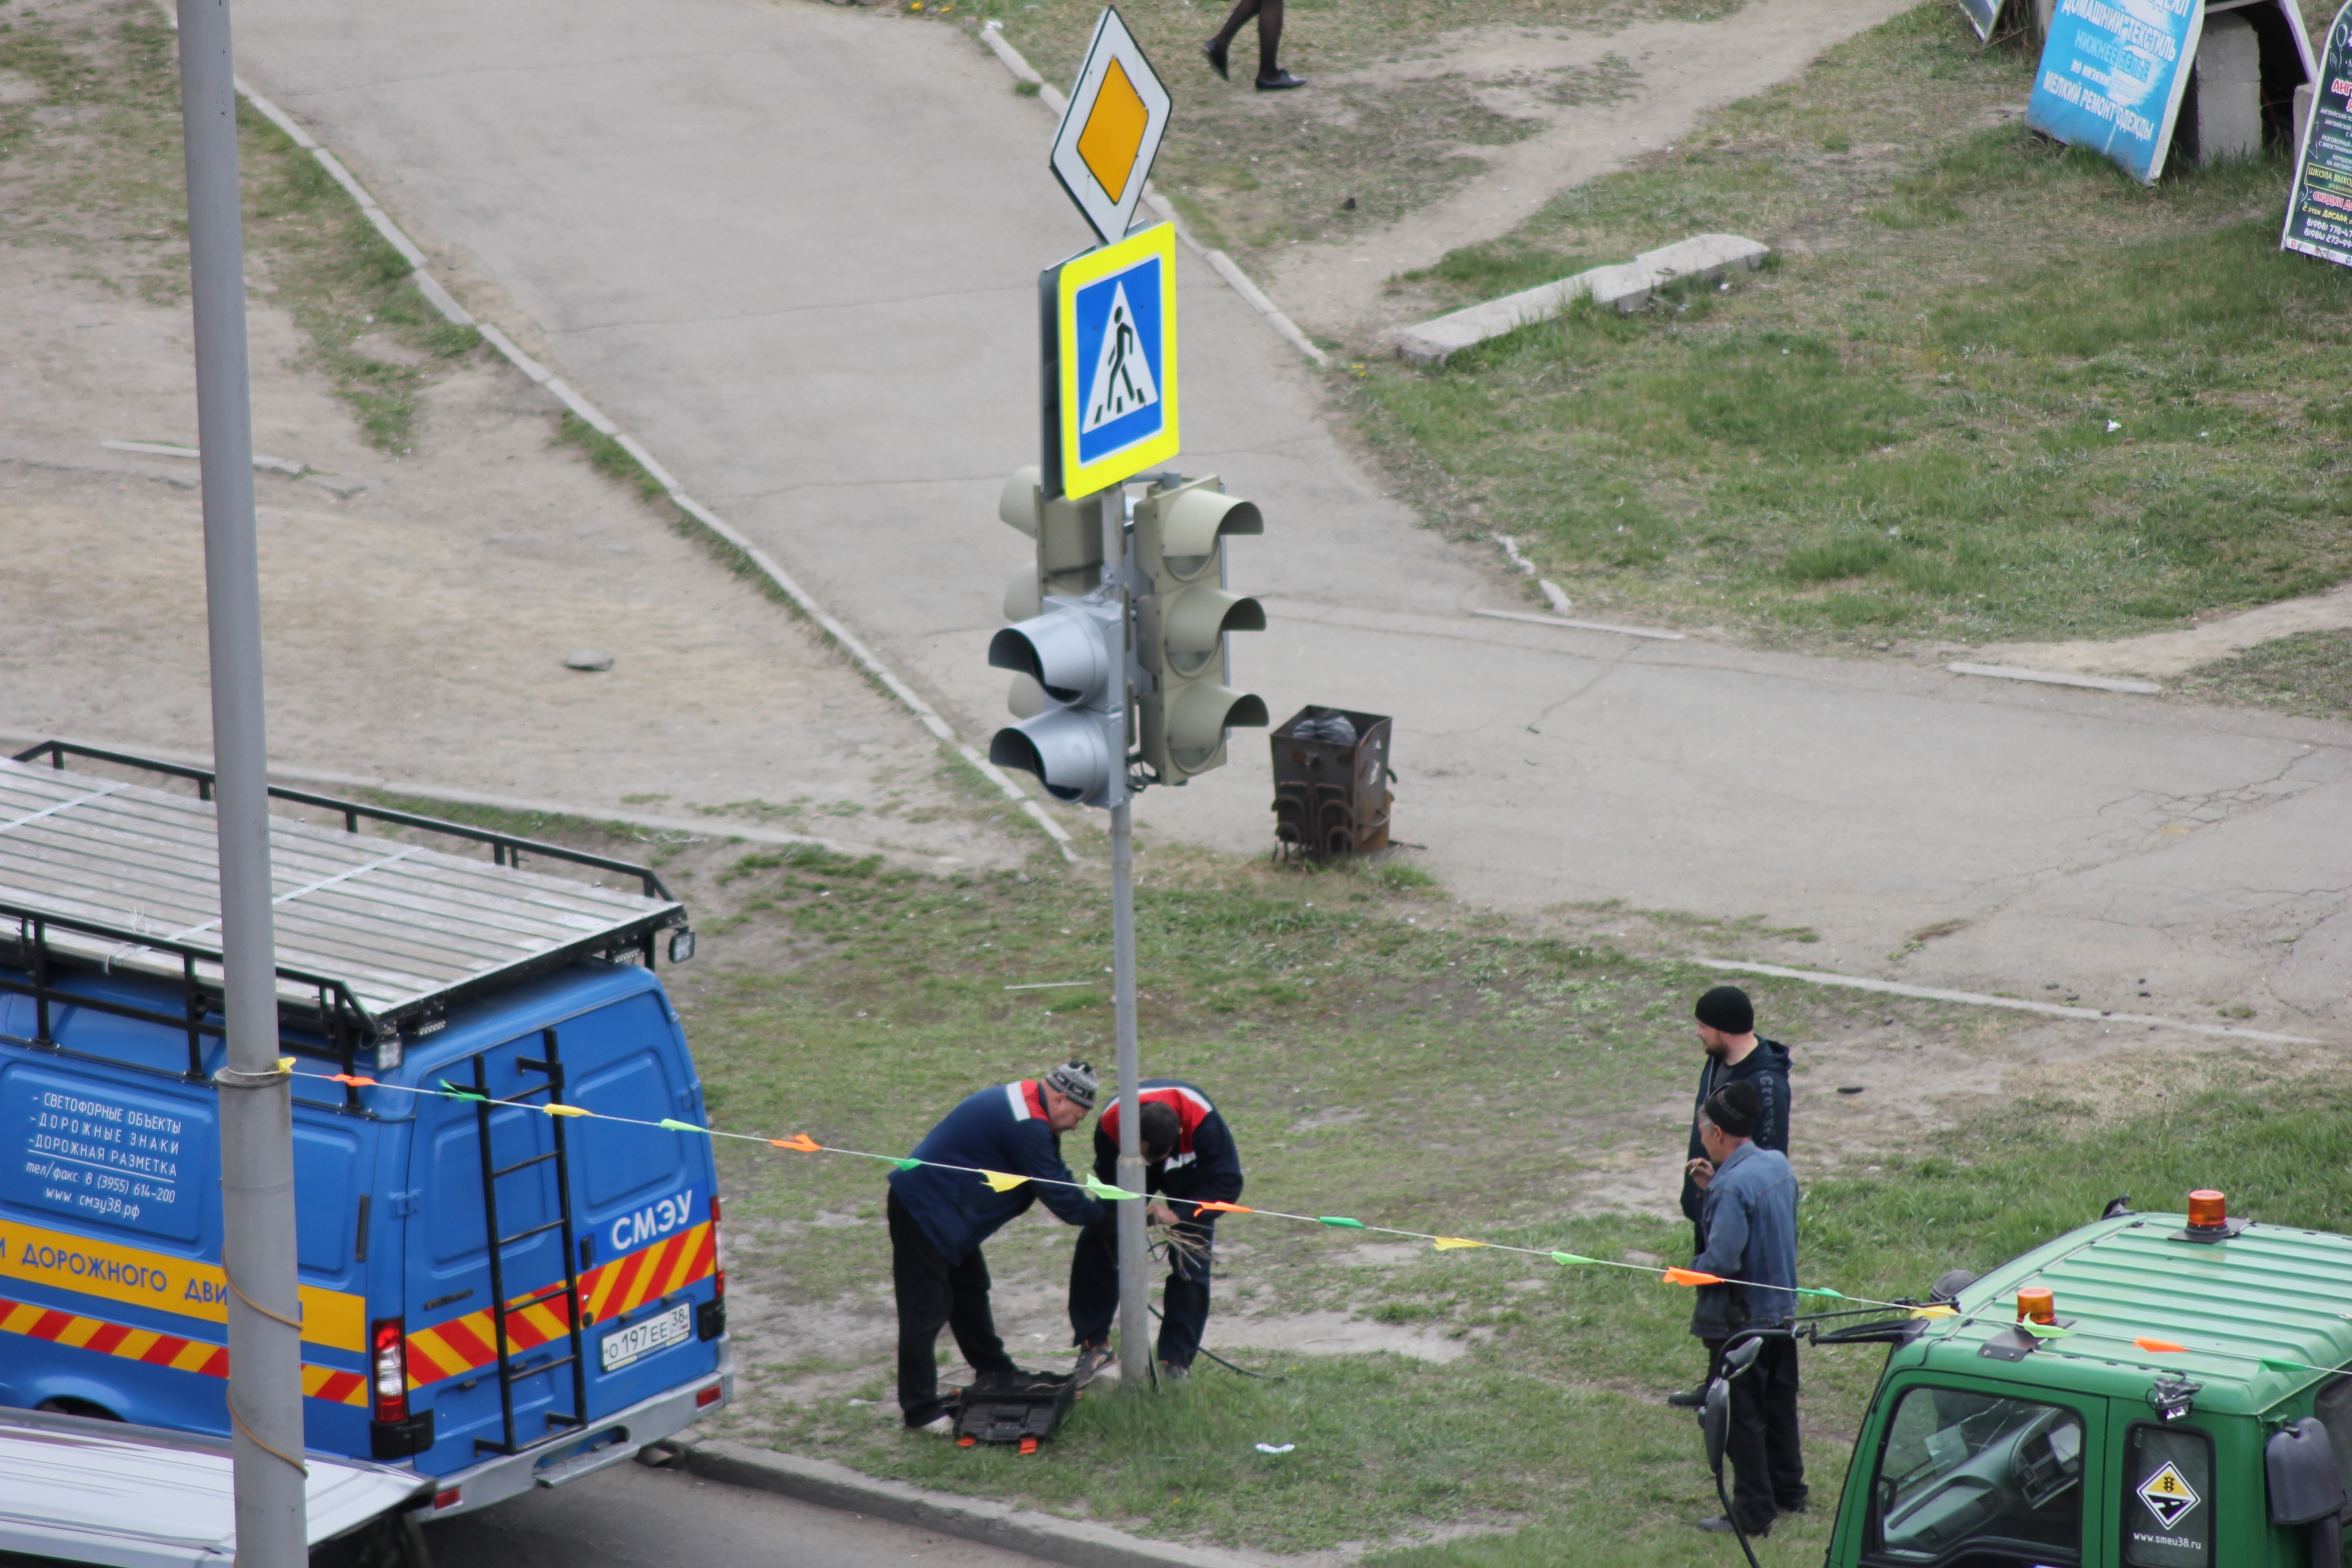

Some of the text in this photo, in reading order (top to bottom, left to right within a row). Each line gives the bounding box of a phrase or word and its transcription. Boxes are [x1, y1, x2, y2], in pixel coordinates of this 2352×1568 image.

[2126, 15, 2176, 62] ТЕКСТИЛЬ
[2074, 29, 2151, 83] НИЖНЕЕ БЕЛЬЕ
[2043, 71, 2154, 142] МЕЛКИЙ РЕМОНТ ОДЕЖДЫ
[2320, 108, 2347, 119] АНГЛИЙСКИЙ
[2324, 119, 2352, 131] АНГЛИЙСКИЙ
[2308, 167, 2352, 188] ШКОЛА ВЫХО
[2312, 191, 2344, 208] СКИДКИ
[44, 1092, 123, 1122] СВЕТОФОРНЫЕ
[128, 1111, 181, 1134] ОБЪЕКТЫ
[130, 1132, 179, 1155] ЗНАКИ
[111, 1151, 177, 1176] РАЗМЕТКА
[85, 1172, 93, 1183] 8
[98, 1175, 129, 1195] (3955)
[133, 1183, 176, 1203] 614-200
[612, 1189, 693, 1250] СМЭУ
[22, 1243, 168, 1292] ДОРОЖНОГО
[2133, 1532, 2201, 1550] www.smeu38.ru
